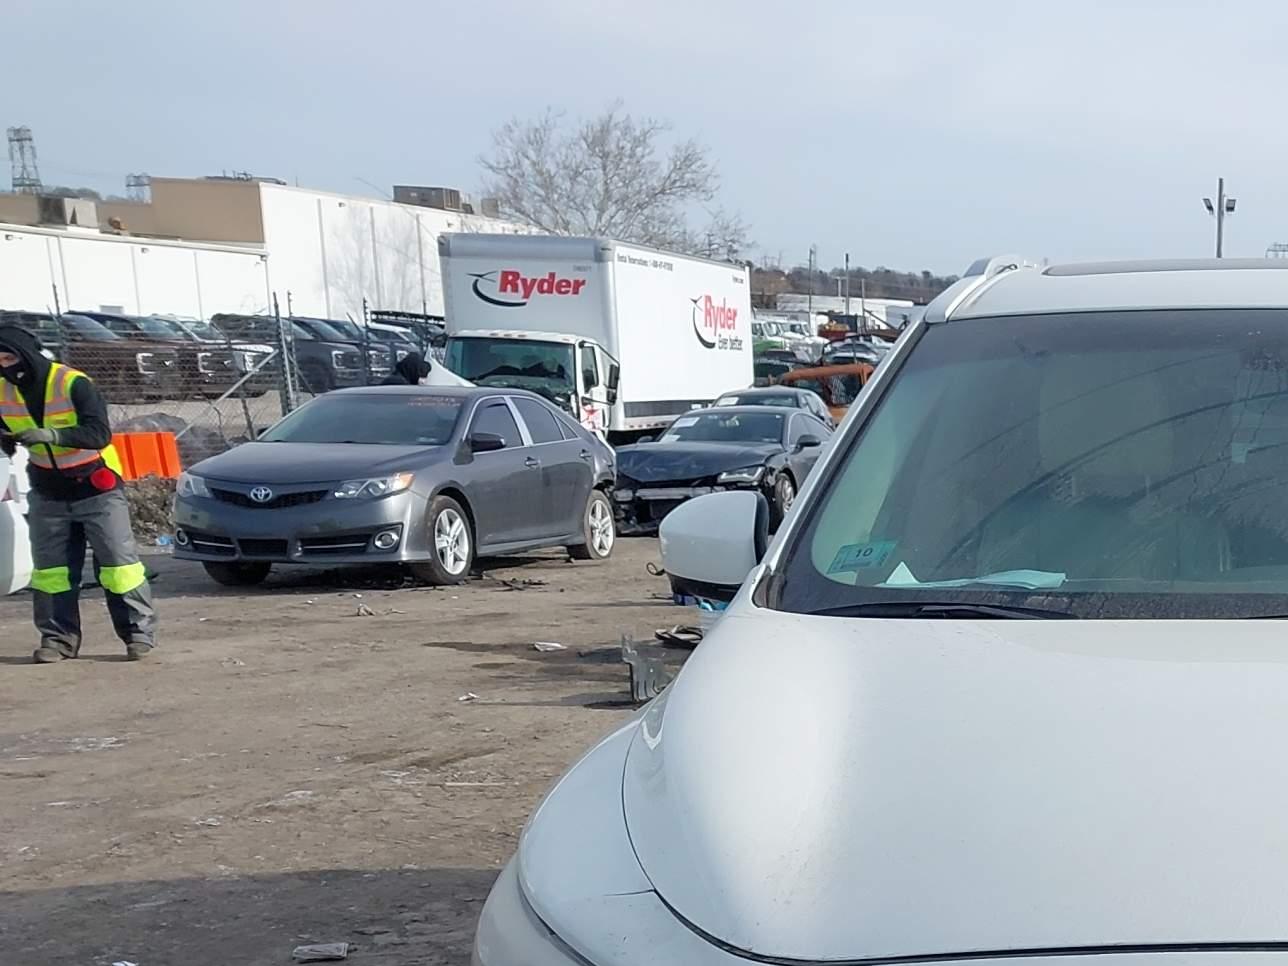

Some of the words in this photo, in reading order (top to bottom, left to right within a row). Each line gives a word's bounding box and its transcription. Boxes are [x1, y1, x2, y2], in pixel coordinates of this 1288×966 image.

[499, 269, 586, 299] Ryder
[704, 295, 738, 337] Ryder
[855, 547, 873, 558] 10
